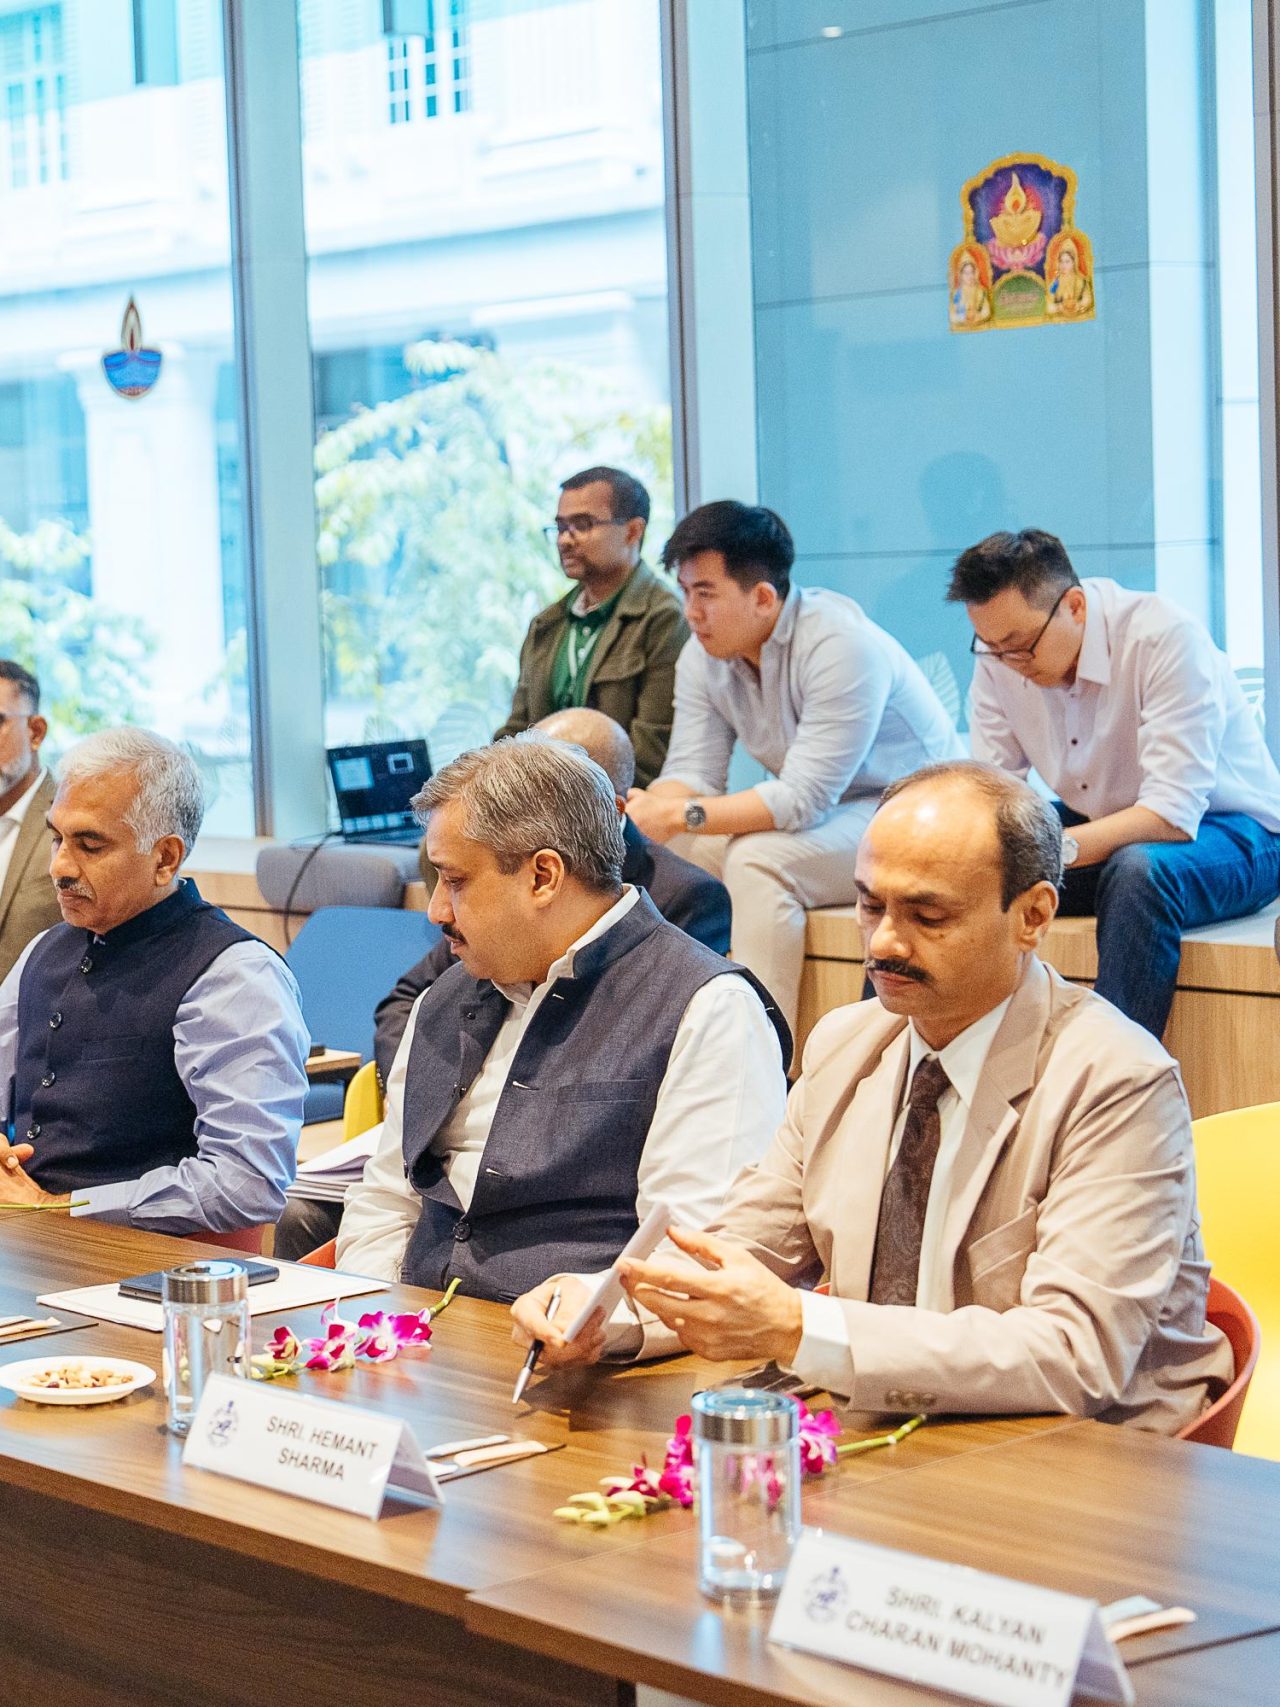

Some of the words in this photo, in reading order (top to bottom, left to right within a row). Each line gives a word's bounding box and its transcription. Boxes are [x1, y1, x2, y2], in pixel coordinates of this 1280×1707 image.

[267, 1415, 304, 1440] SHRI.
[310, 1426, 379, 1459] HEMANT
[278, 1447, 345, 1480] SHARMA
[950, 1604, 1048, 1645] KALYAN
[844, 1609, 939, 1656] CHARAN
[946, 1639, 1071, 1689] MOHANTY
